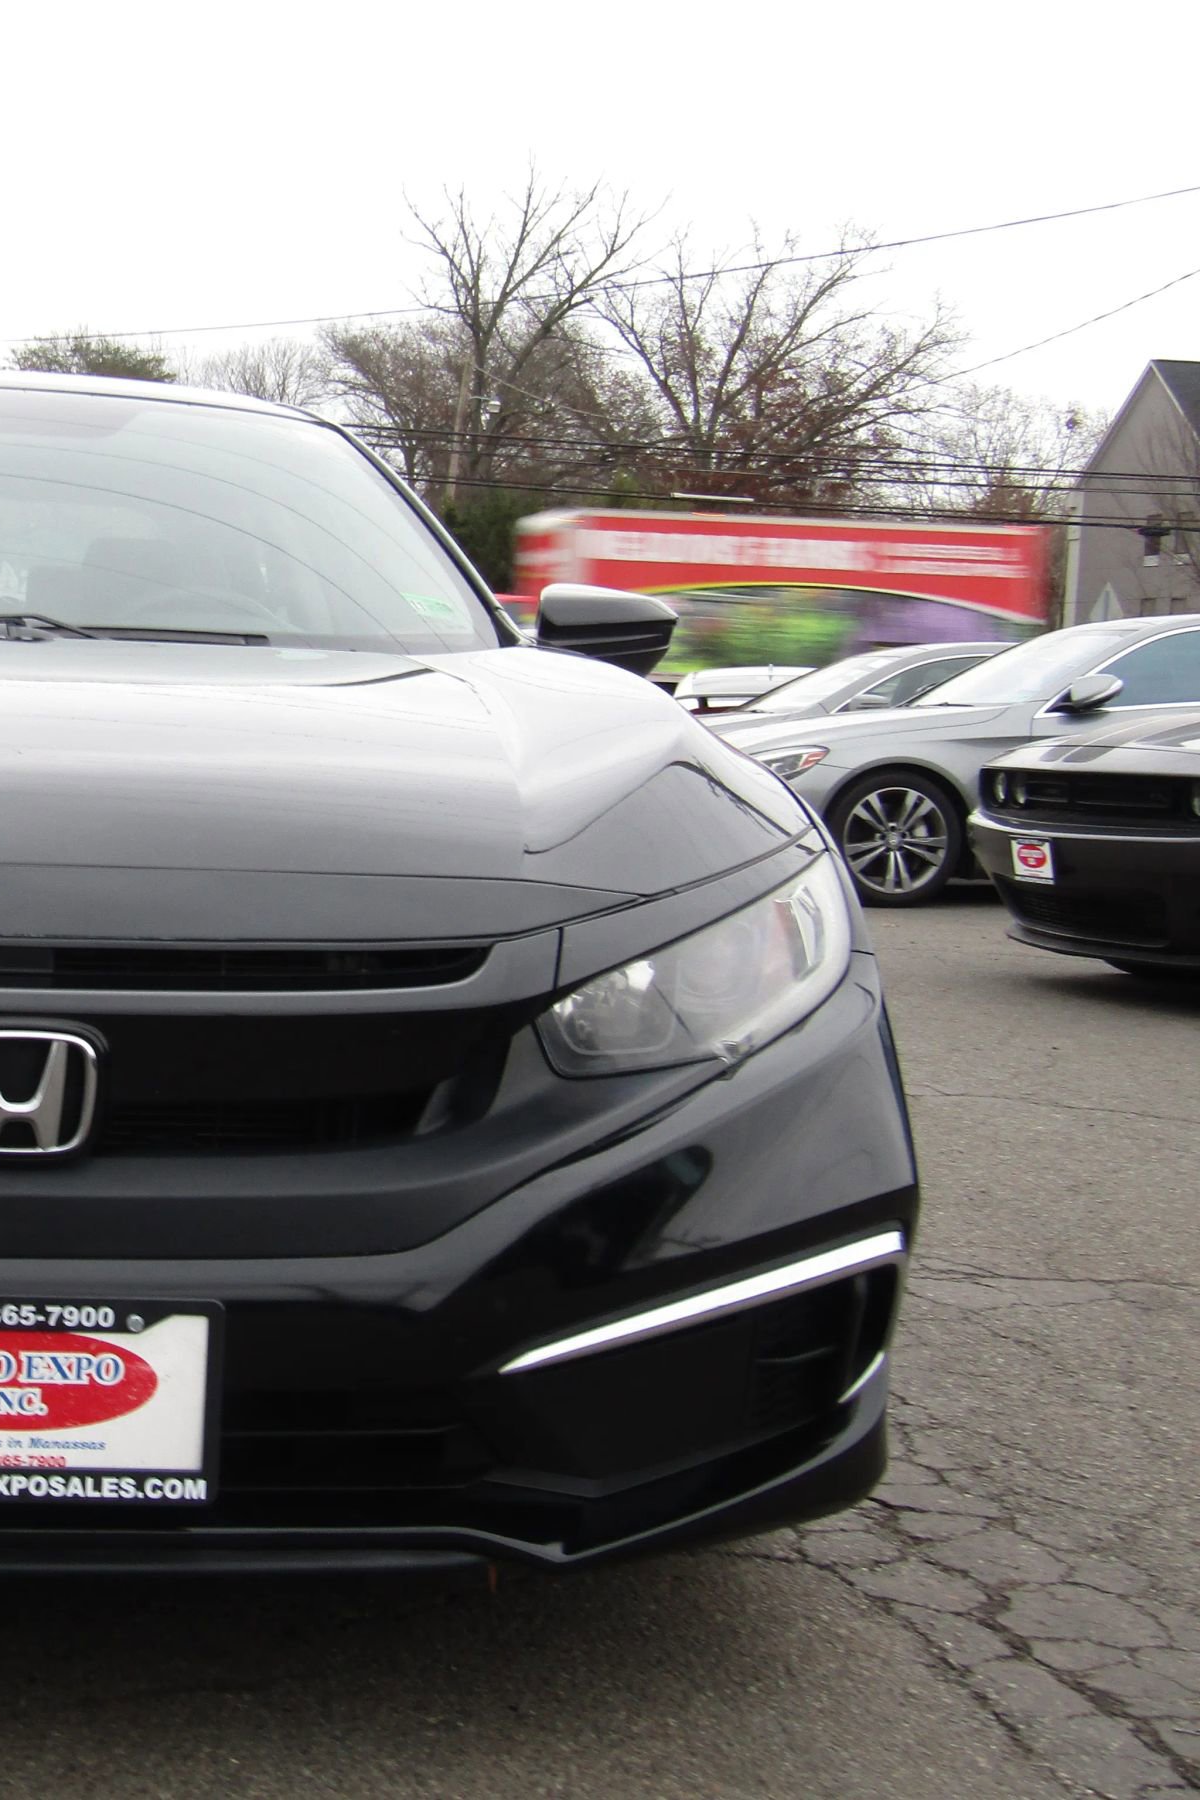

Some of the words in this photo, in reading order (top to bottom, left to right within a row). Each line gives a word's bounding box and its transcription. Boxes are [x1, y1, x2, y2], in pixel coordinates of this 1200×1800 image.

[18, 1352, 125, 1386] EXPO
[7, 1437, 23, 1449] in
[29, 1437, 106, 1451] Manassas
